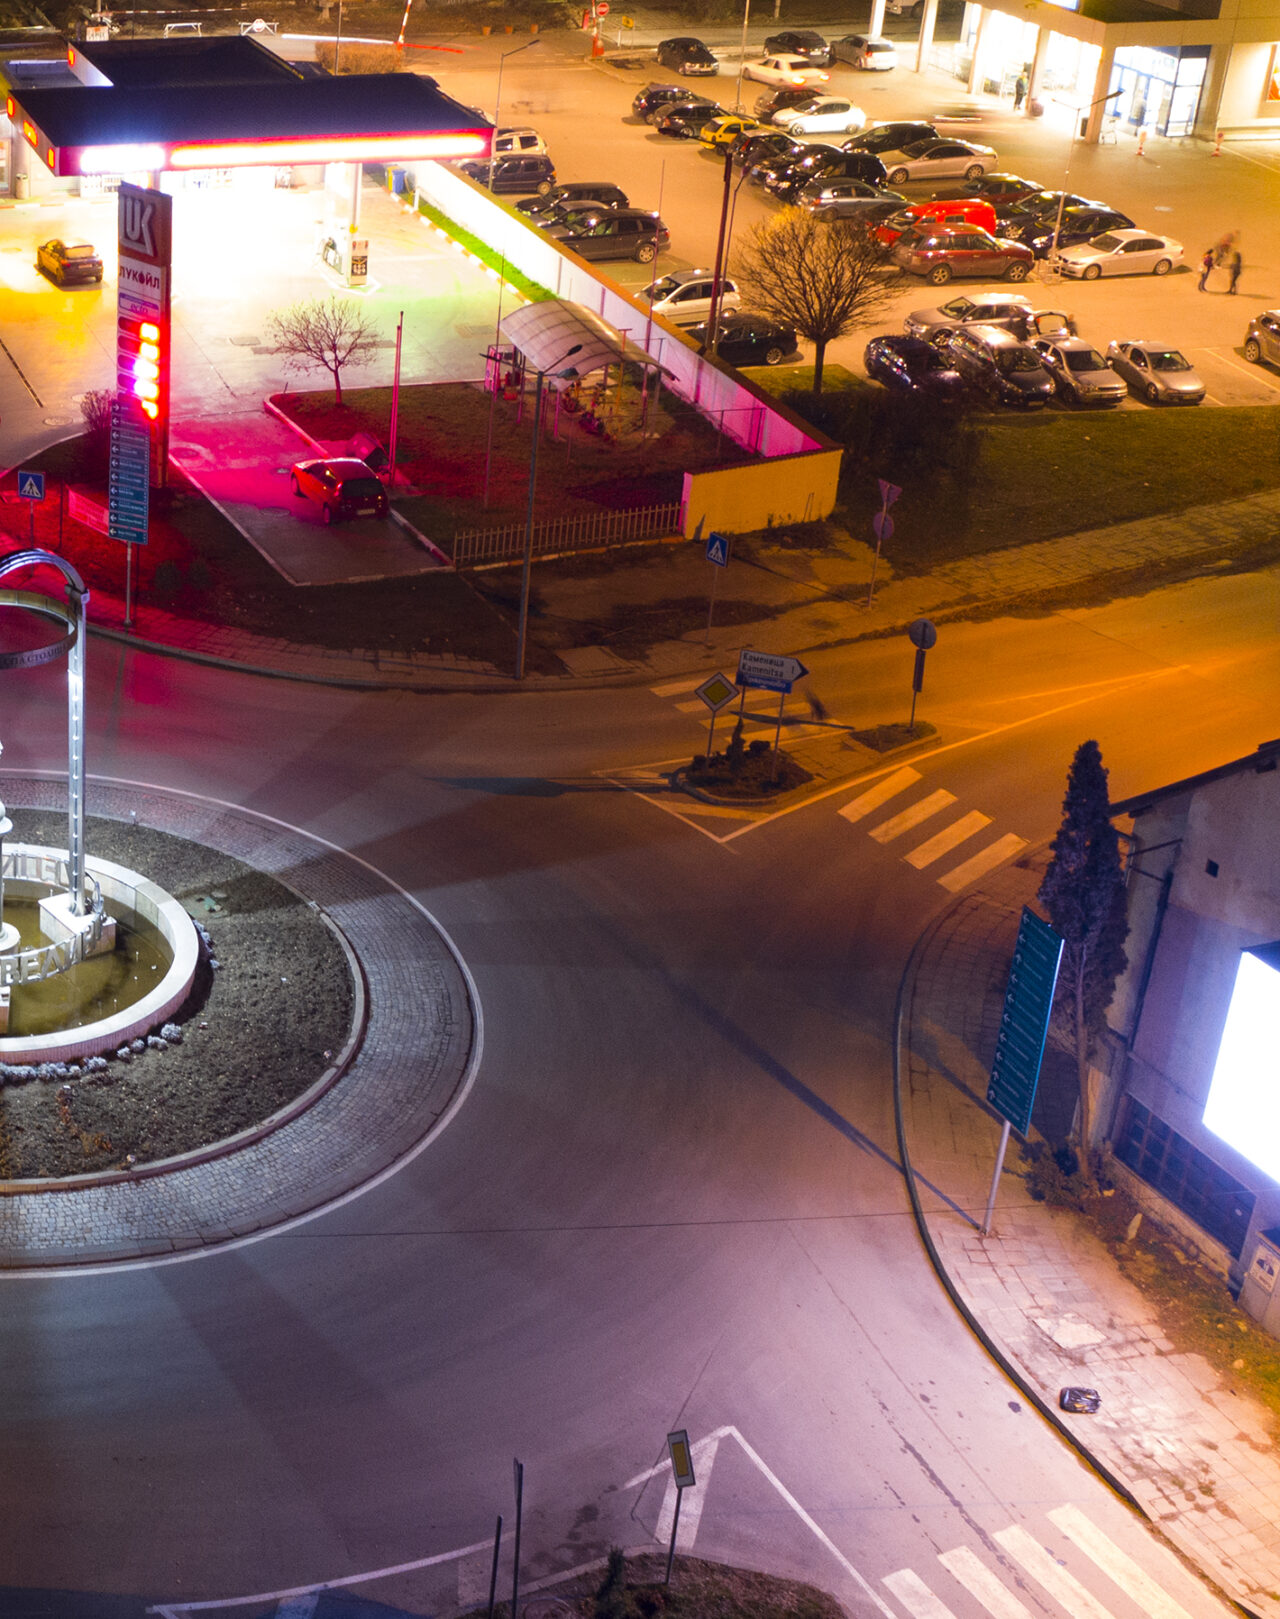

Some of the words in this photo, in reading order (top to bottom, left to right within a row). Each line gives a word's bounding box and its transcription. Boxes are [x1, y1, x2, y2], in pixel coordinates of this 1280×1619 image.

[119, 265, 160, 290] ЛУКОЙЛ
[743, 652, 784, 667] Каменица
[742, 663, 784, 678] Kamenitsa
